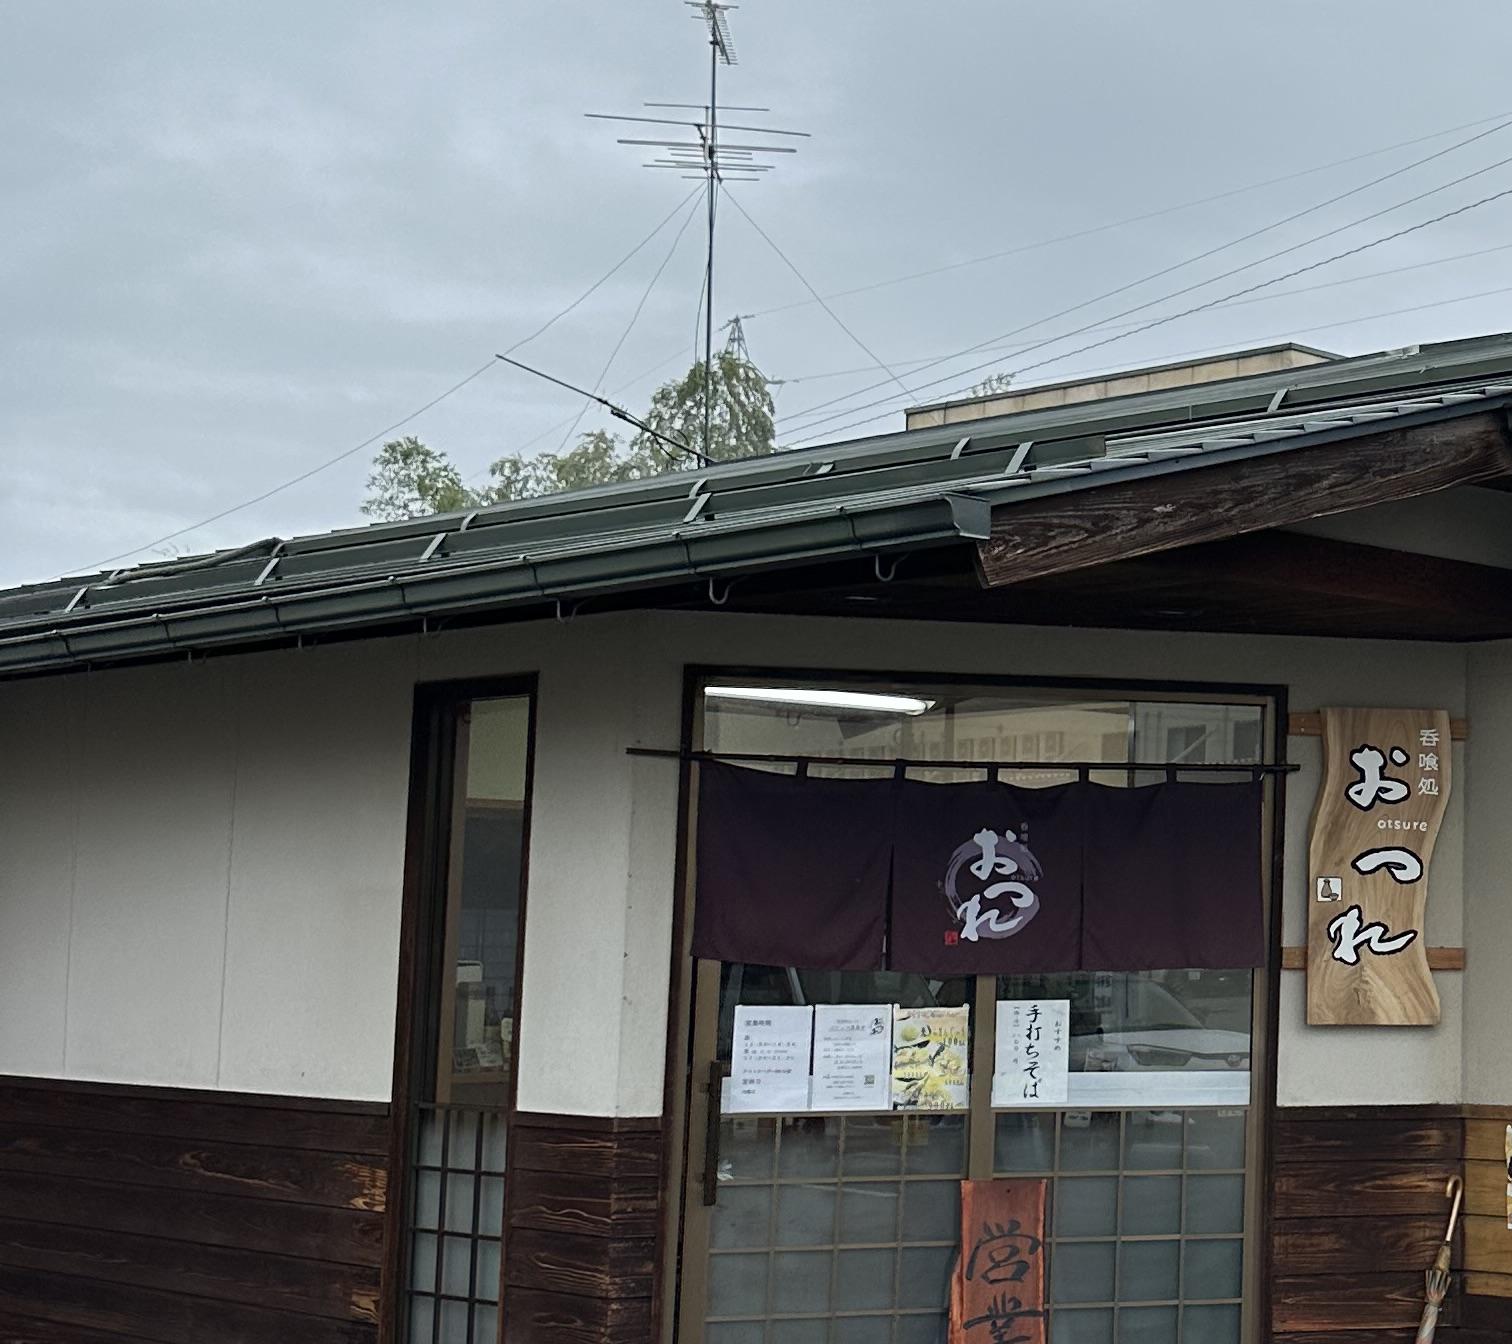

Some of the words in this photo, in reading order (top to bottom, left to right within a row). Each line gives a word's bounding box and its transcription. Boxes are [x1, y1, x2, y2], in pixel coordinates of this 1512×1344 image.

[1417, 728, 1440, 797] 呑喰処
[1327, 743, 1425, 966] おつれ
[1377, 818, 1428, 833] otsure
[956, 827, 1035, 942] おつれ
[1023, 1004, 1043, 1099] 手打ちそば
